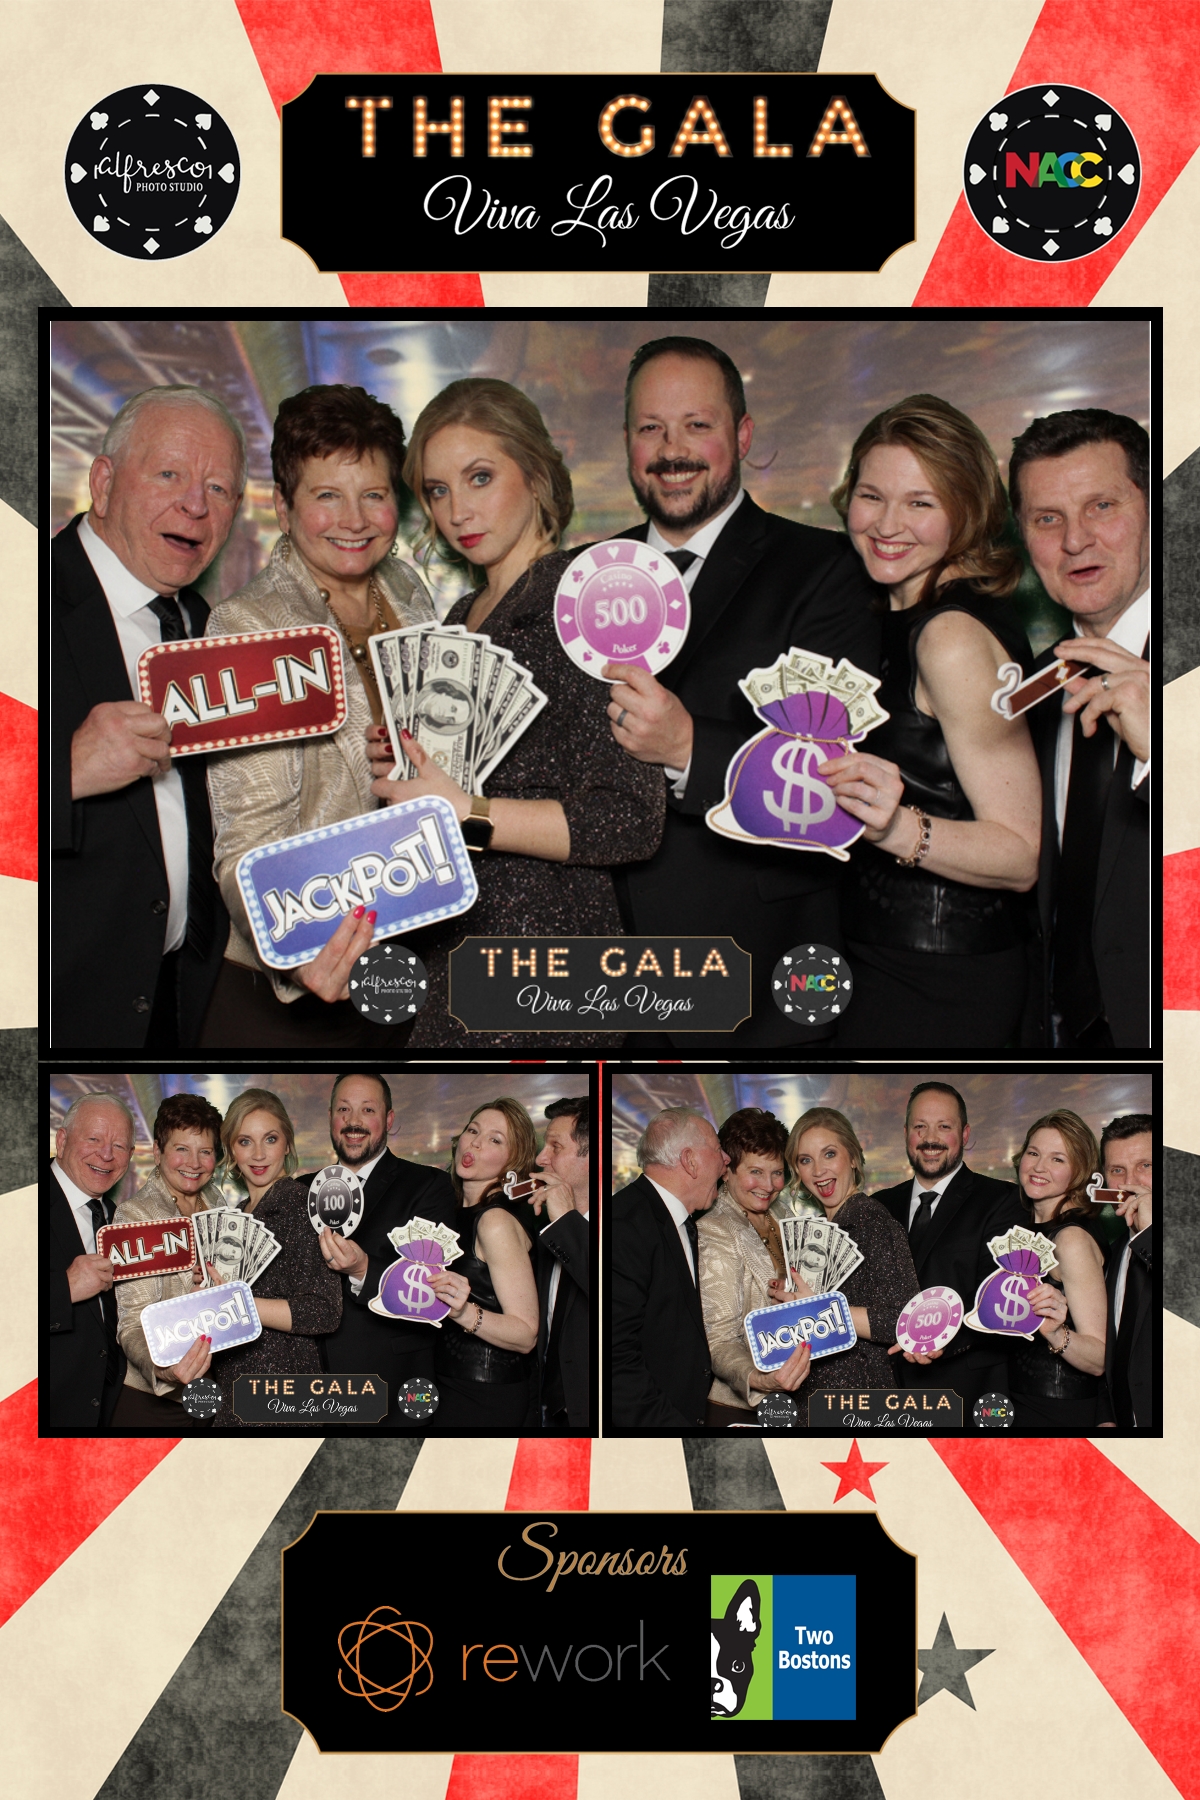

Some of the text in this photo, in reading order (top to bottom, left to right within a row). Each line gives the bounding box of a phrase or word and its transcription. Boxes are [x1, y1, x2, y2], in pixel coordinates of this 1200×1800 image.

[600, 571, 633, 584] Casino
[594, 594, 648, 630] 500
[612, 643, 637, 654] Poker
[161, 648, 332, 729] ALL-IN
[262, 814, 456, 943] JACKPOT!
[323, 1194, 345, 1211] 100
[109, 1228, 190, 1266] ALL-IN
[154, 1290, 251, 1352] JACKPOT!
[757, 1300, 848, 1358] JACKPOT!
[915, 1312, 942, 1329] 500
